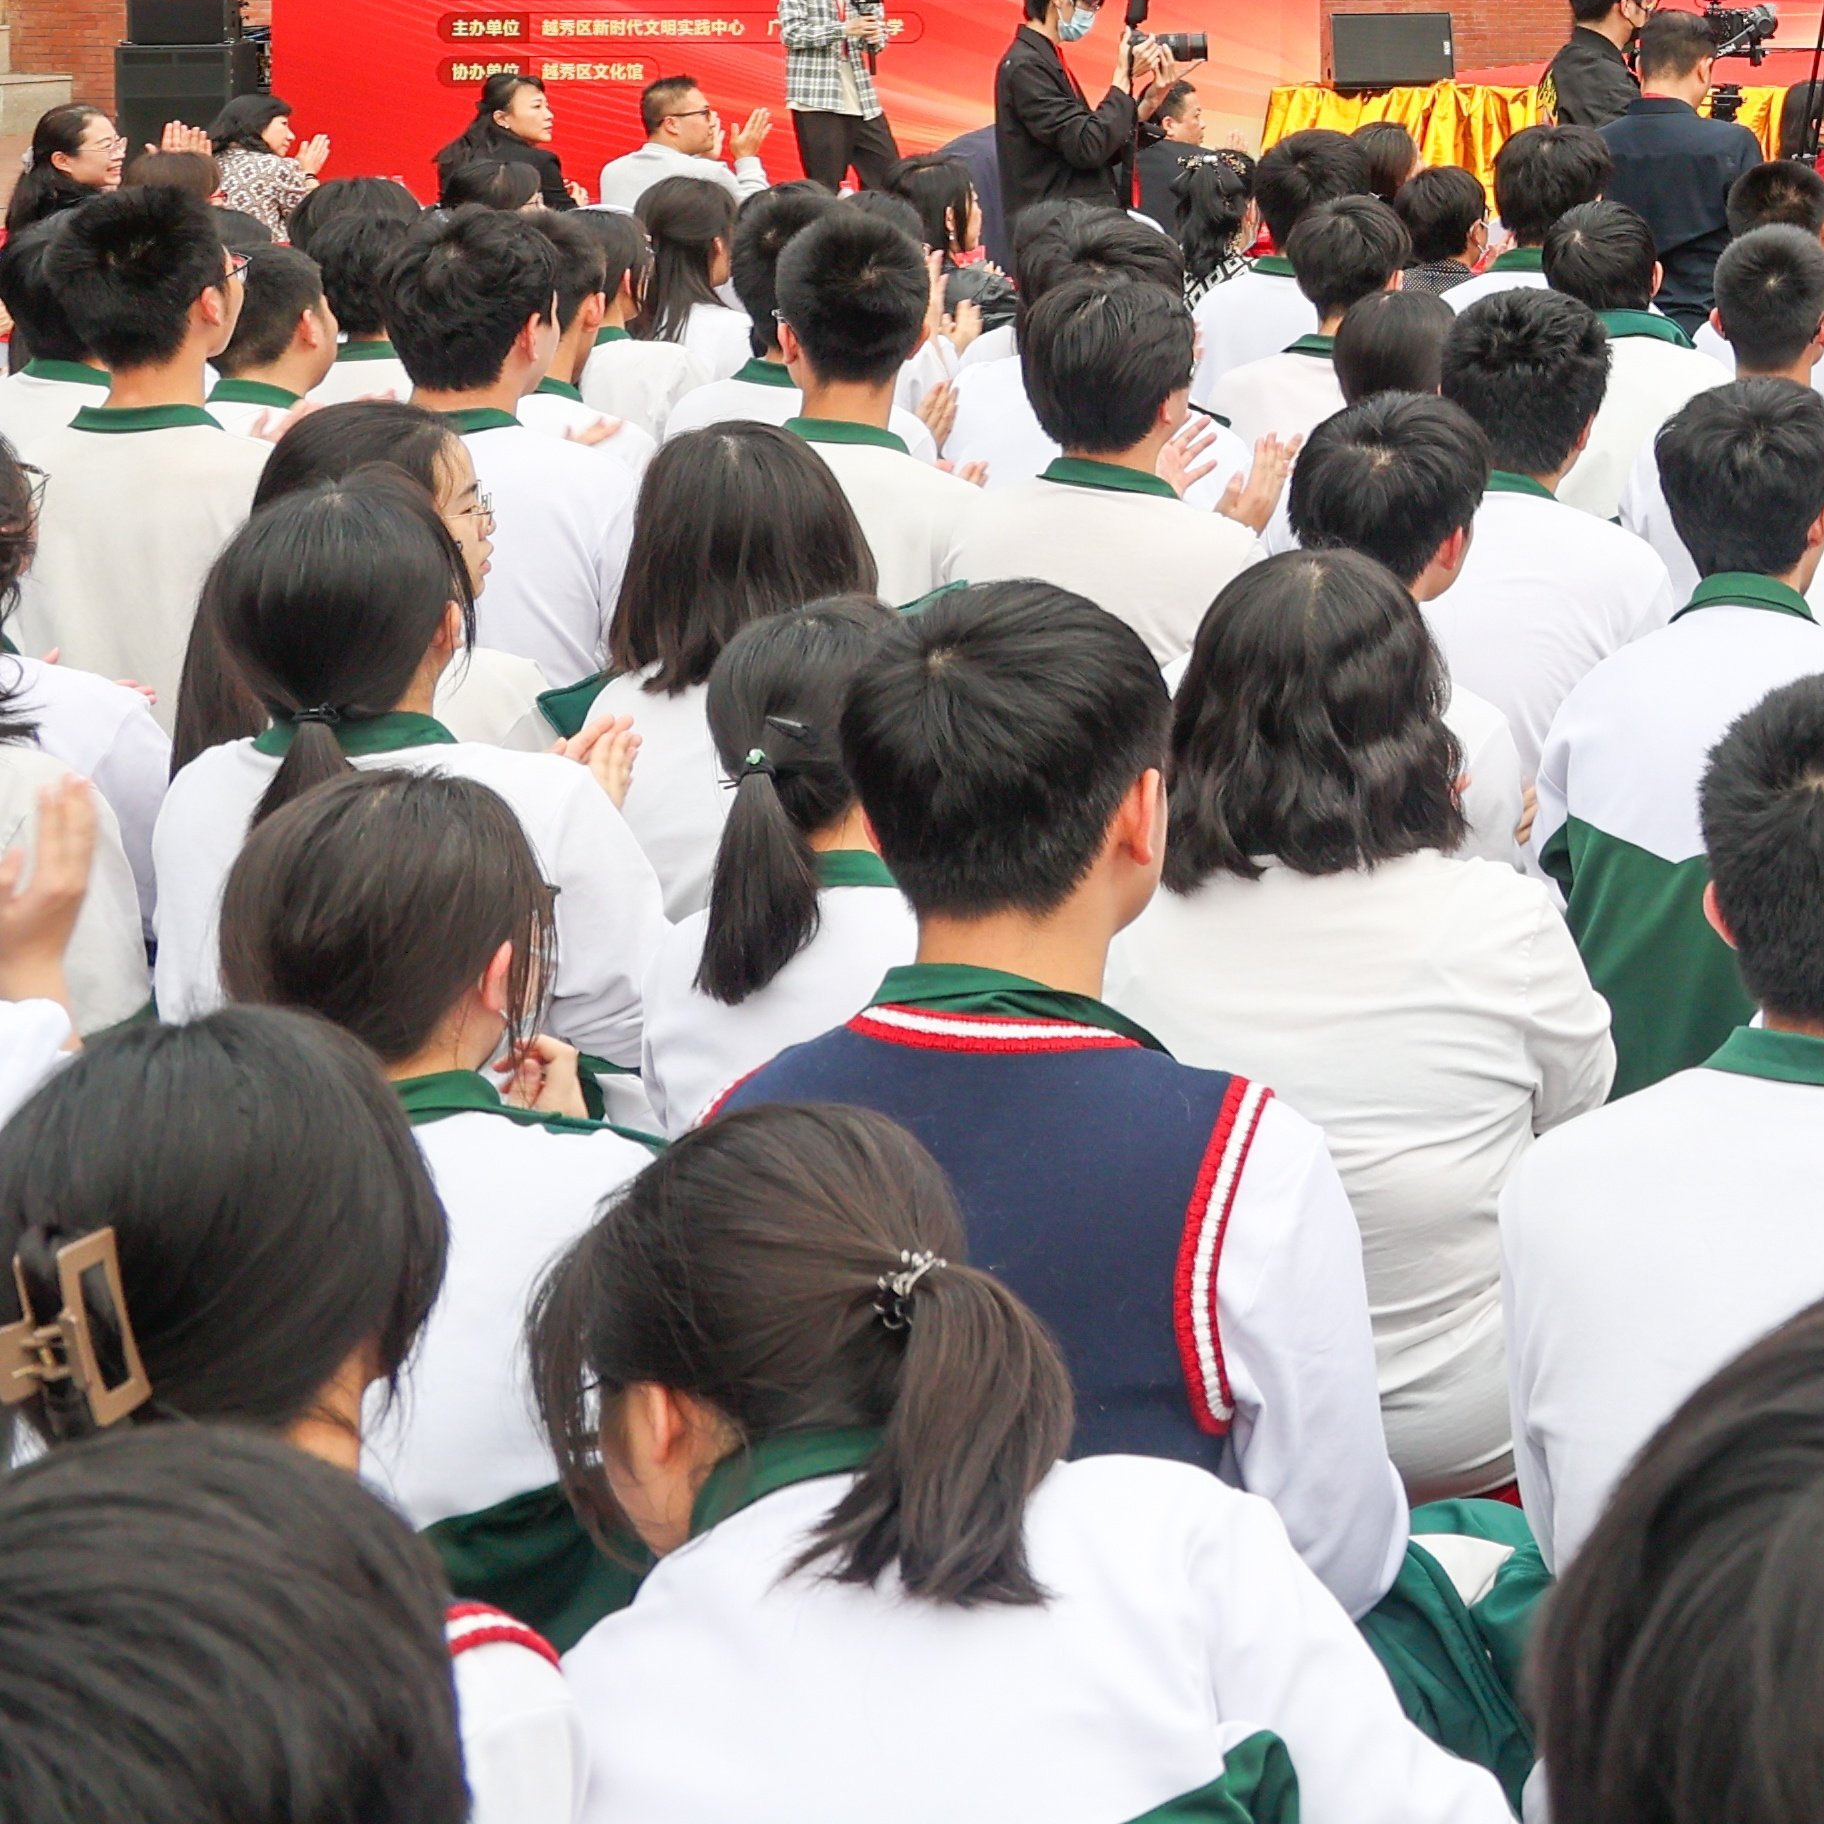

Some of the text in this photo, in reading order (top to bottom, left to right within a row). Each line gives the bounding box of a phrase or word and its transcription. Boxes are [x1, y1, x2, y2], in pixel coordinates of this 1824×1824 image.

[451, 19, 521, 37] 主办单位
[541, 18, 745, 37] 越秀区新时代文明实践中心
[541, 62, 644, 81] 越秀区文化馆
